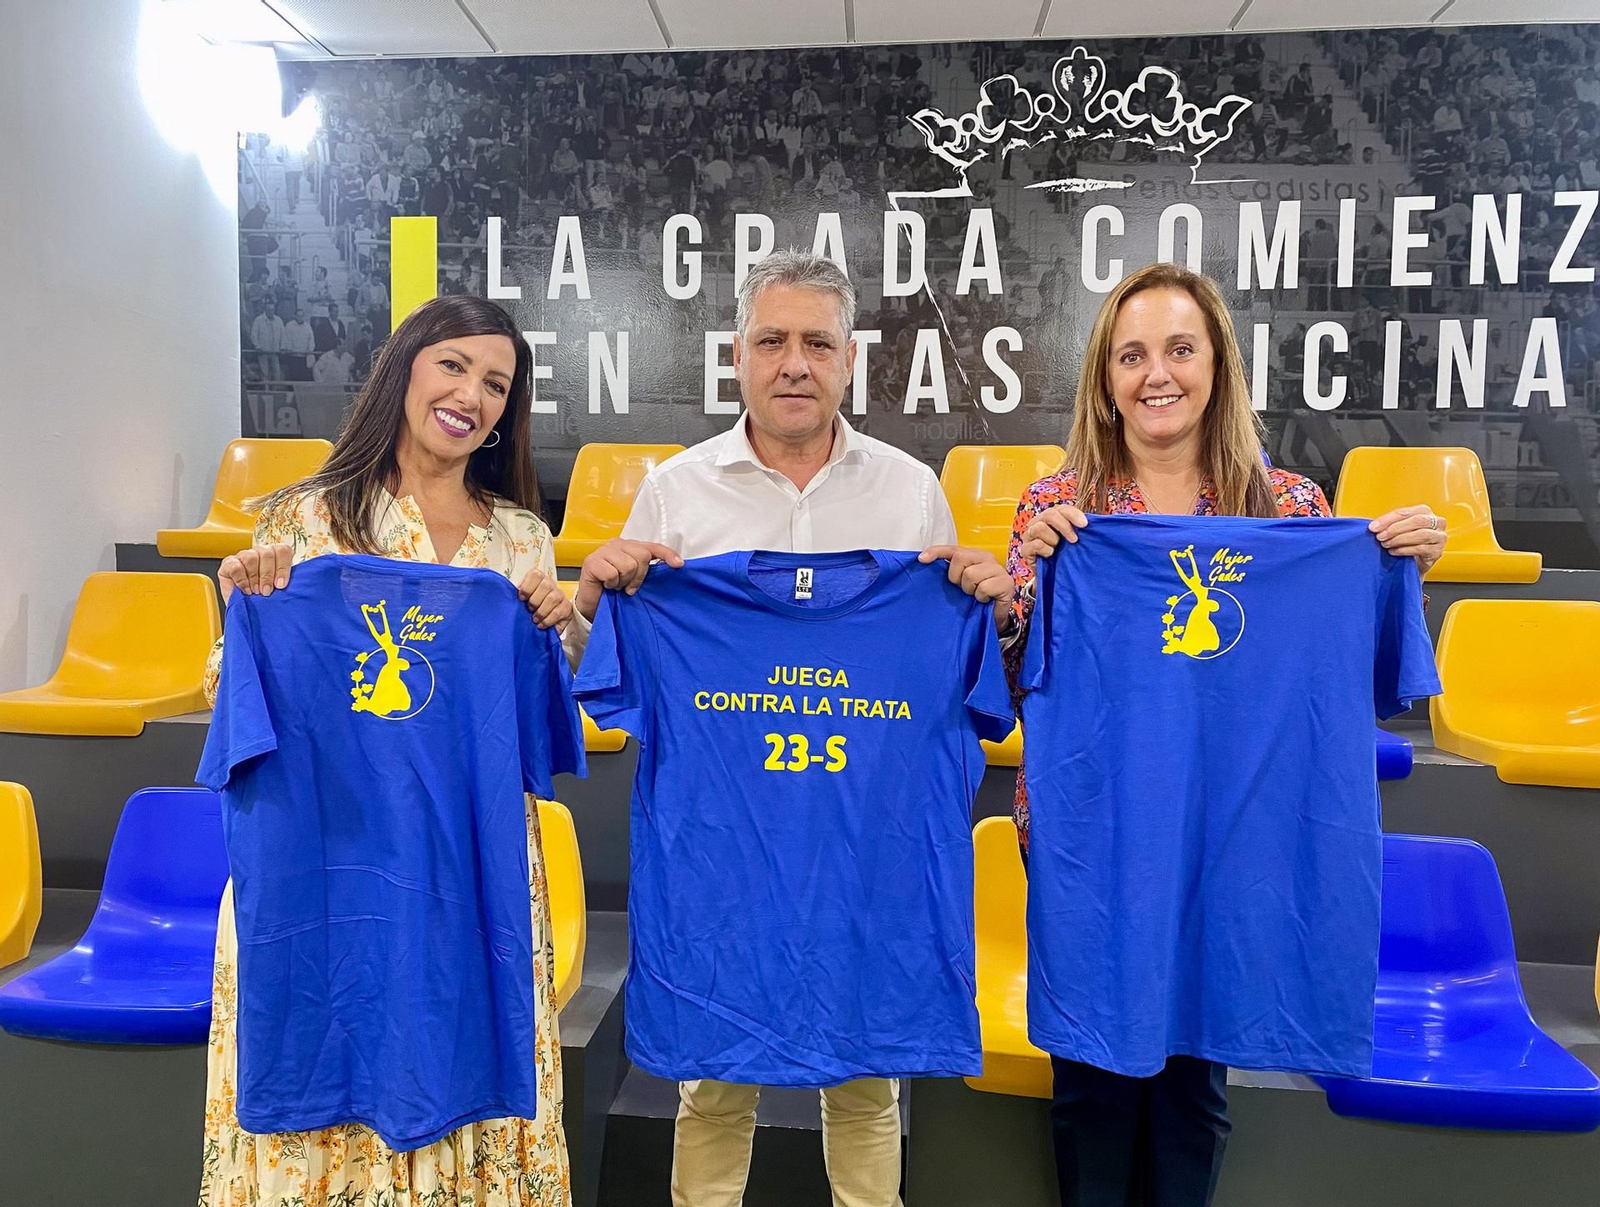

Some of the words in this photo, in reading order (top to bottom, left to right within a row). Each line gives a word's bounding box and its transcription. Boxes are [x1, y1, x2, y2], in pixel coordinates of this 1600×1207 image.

[487, 215, 591, 300] LA
[662, 207, 1004, 300] GRADA
[1081, 190, 1600, 293] COMIENZ
[522, 331, 629, 414] EN
[704, 326, 1023, 415] ETAS
[1209, 548, 1253, 570] Mujer
[1208, 565, 1246, 587] Gades
[401, 605, 444, 629] Mujer
[399, 623, 436, 646] Gades
[767, 666, 849, 688] JUEGA
[694, 691, 796, 714] CONTRA
[802, 696, 833, 716] LA
[839, 698, 912, 720] TRATA
[764, 733, 847, 773] 23-S
